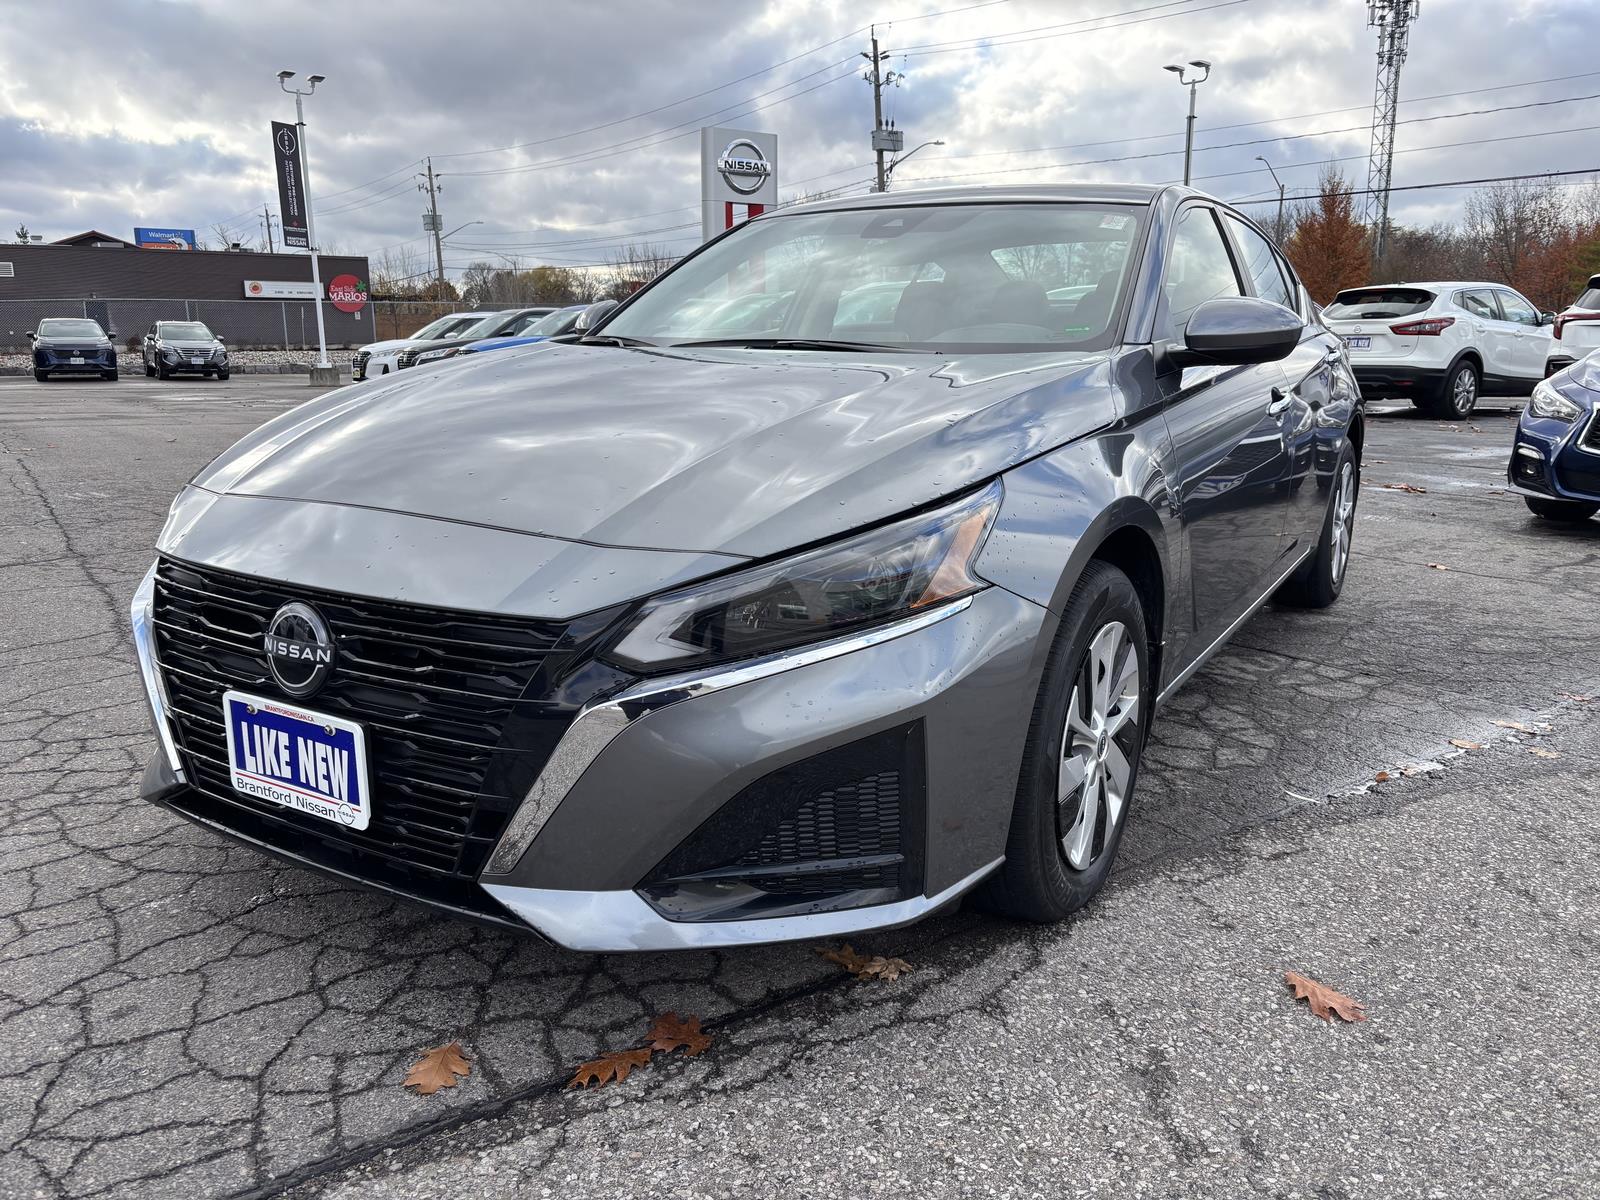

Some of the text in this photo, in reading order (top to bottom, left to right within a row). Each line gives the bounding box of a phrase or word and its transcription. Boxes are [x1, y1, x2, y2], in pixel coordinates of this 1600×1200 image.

[724, 159, 768, 173] NISSAN
[264, 636, 331, 663] NISSAN
[241, 721, 348, 802] LIKE NEW
[237, 777, 336, 819] Brantford Nissan
[337, 809, 356, 819] NISSAN
